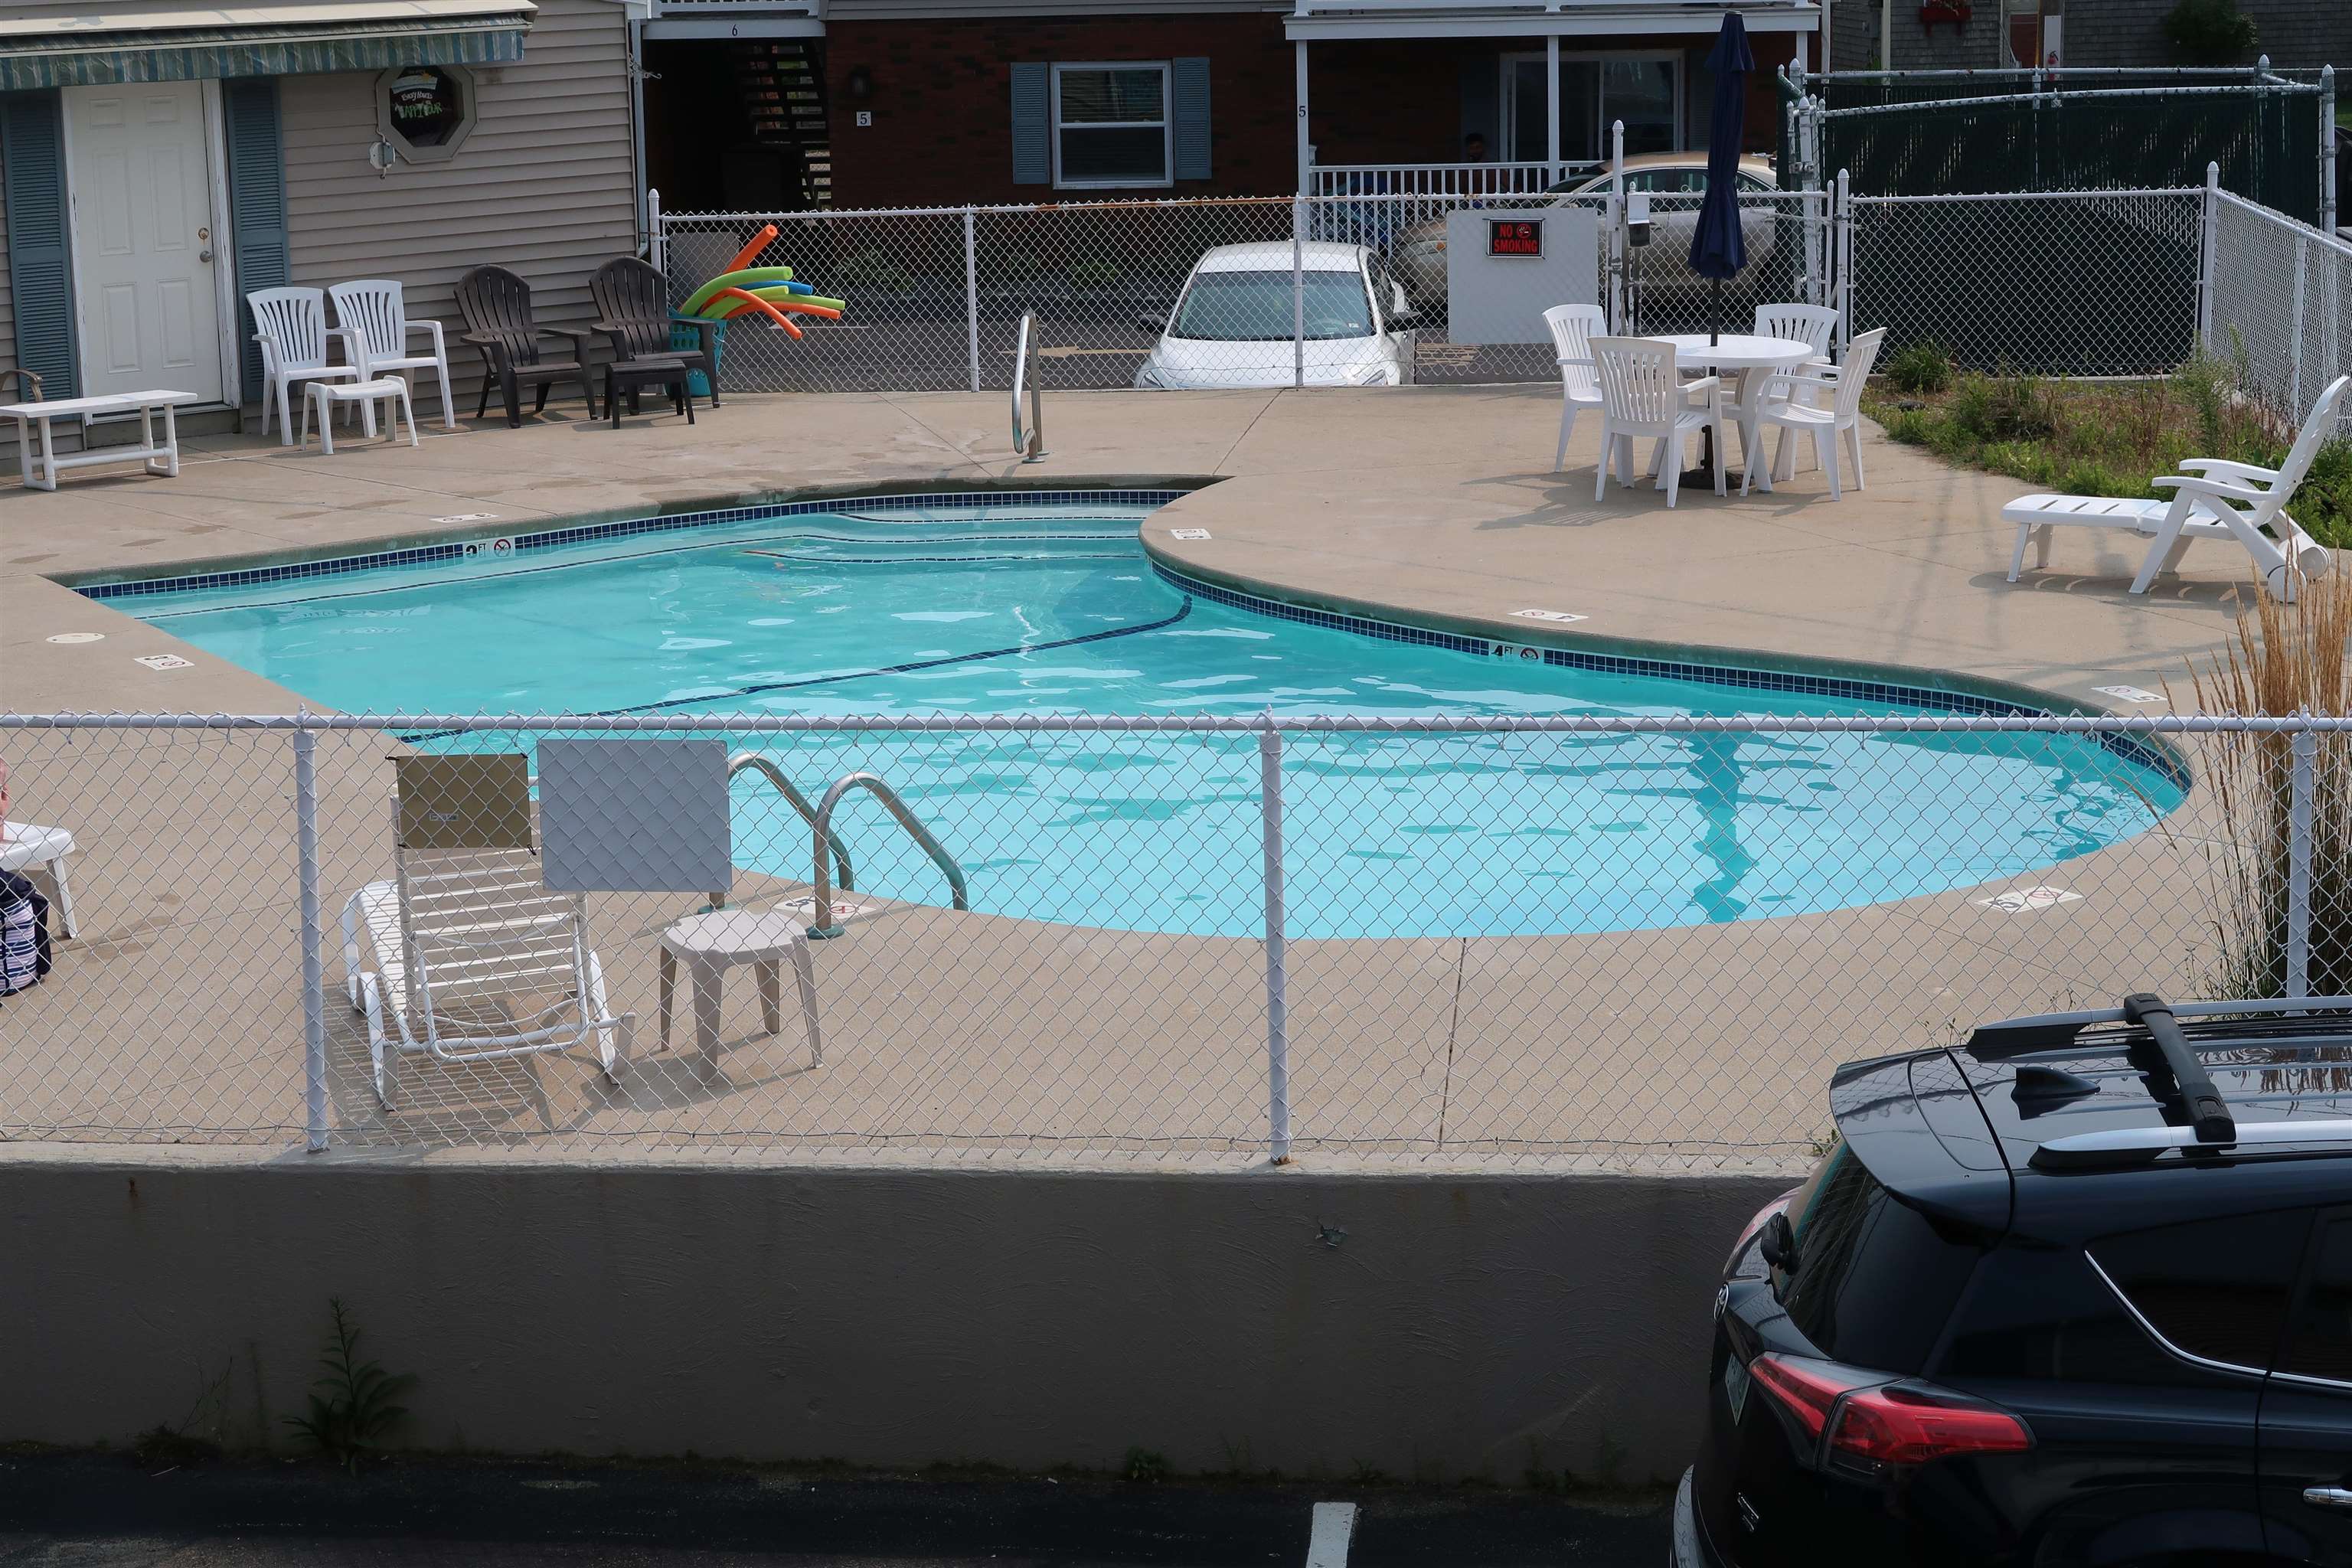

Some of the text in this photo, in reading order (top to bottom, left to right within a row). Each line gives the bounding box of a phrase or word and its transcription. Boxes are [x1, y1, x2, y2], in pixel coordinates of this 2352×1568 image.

[732, 24, 738, 36] 6
[1298, 106, 1306, 117] 5
[860, 113, 867, 125] 5
[1500, 224, 1513, 237] NO
[1494, 239, 1538, 253] SMOKING
